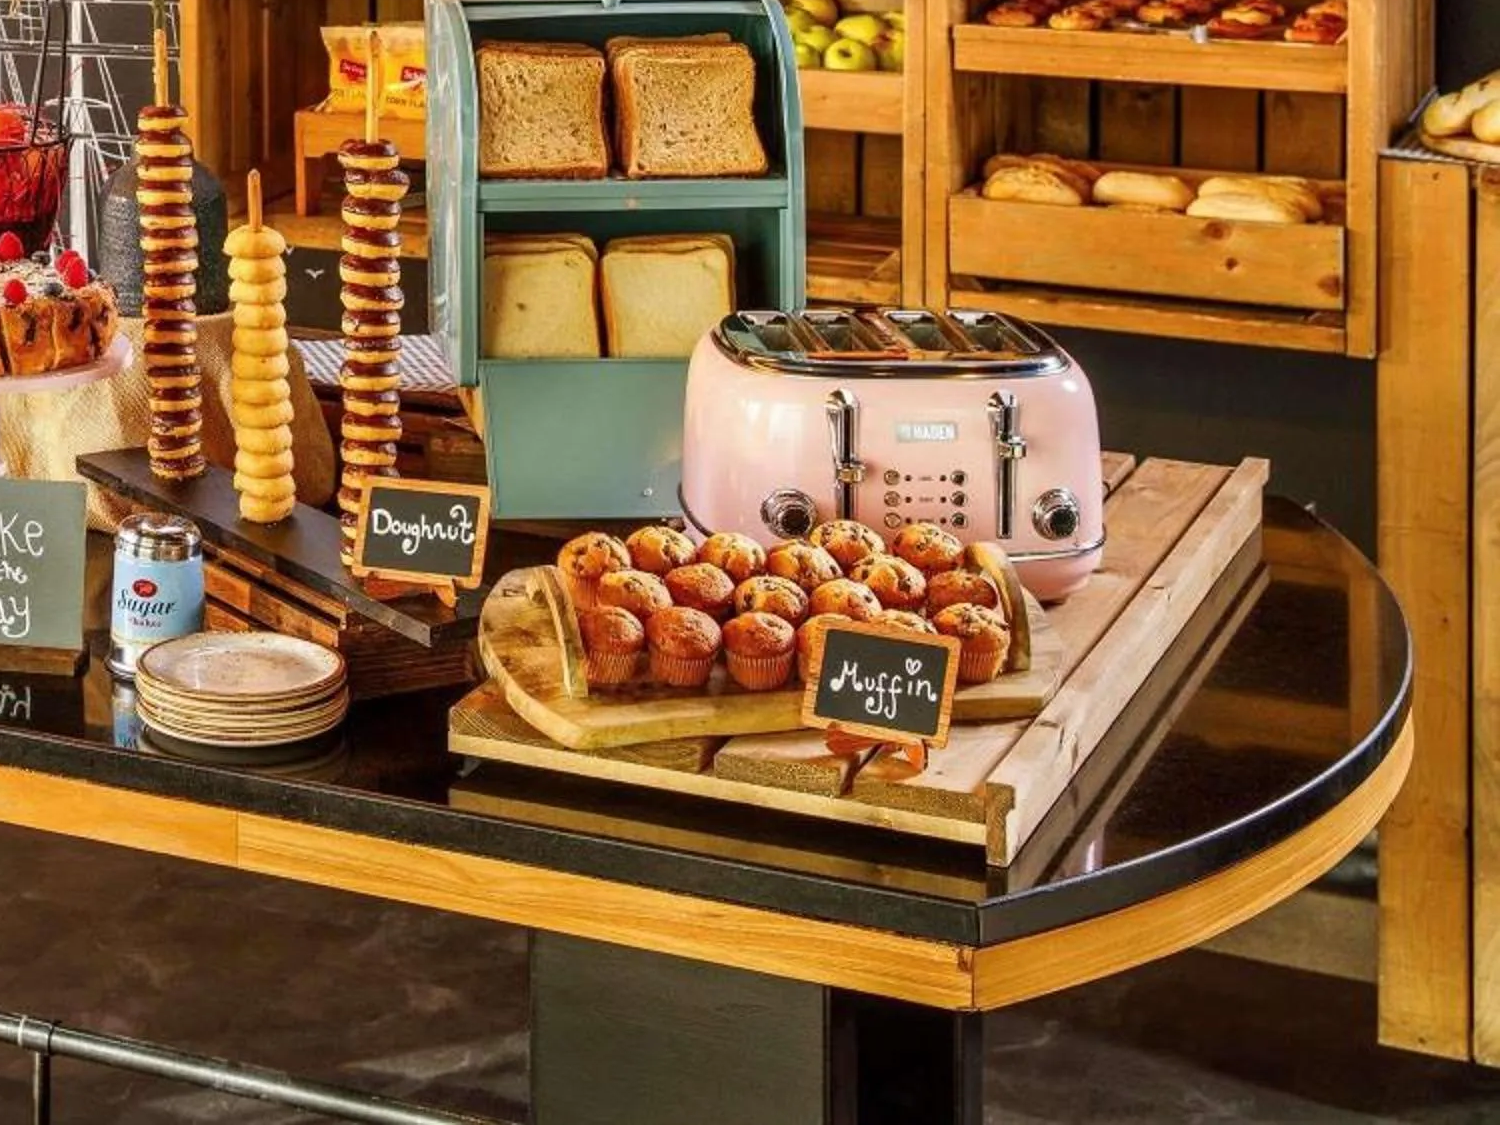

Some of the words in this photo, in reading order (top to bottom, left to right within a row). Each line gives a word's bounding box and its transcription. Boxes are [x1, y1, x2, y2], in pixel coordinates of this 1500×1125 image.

[372, 504, 476, 555] Doughnut
[117, 589, 178, 618] Sugar
[830, 657, 937, 719] Muffin
